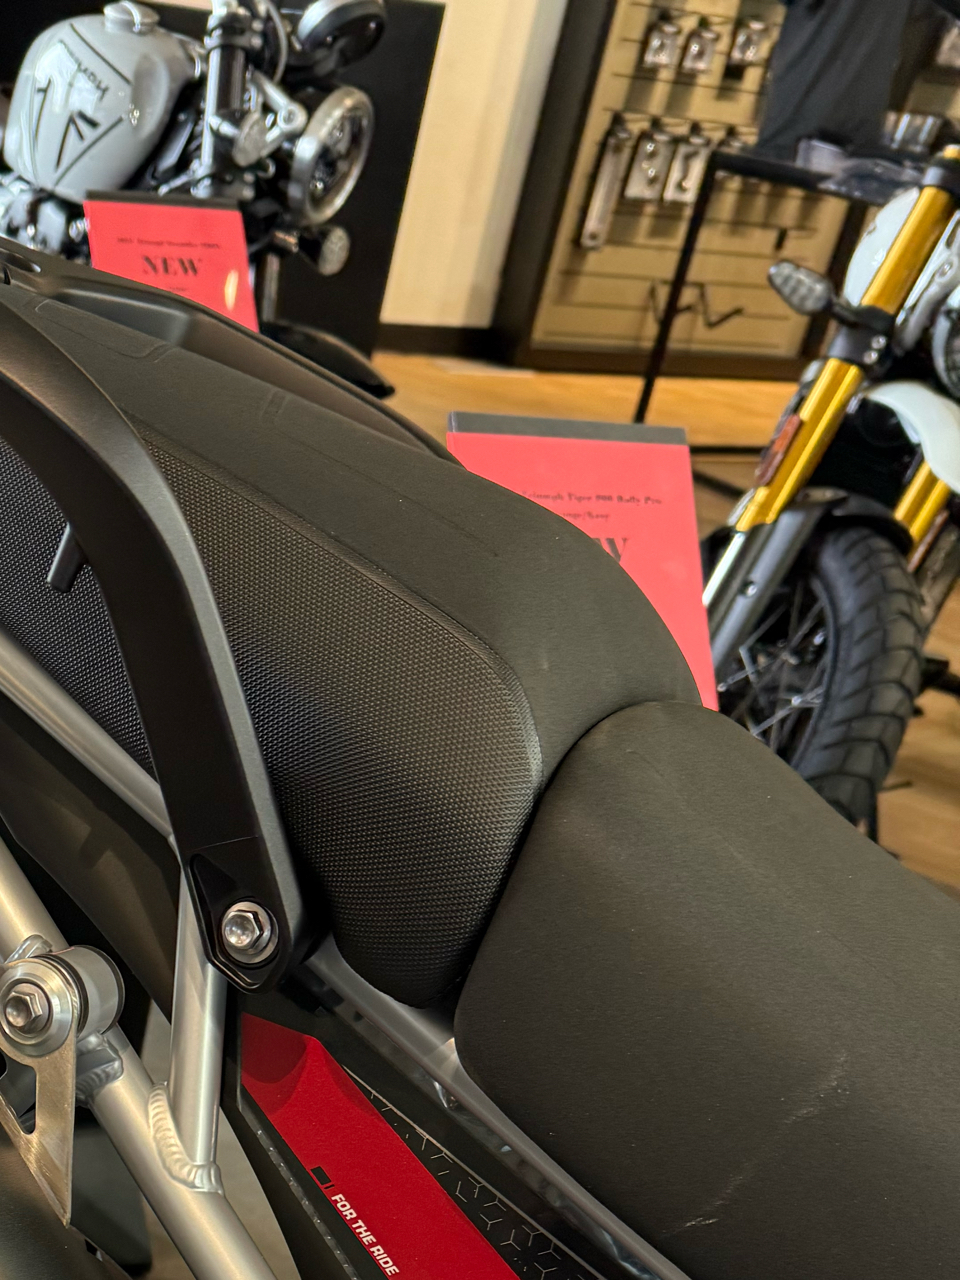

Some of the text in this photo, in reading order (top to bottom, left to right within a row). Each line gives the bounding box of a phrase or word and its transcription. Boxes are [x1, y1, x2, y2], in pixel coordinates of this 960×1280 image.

[143, 256, 203, 276] NEW
[568, 492, 592, 503] Tiger
[617, 494, 641, 506] Rally
[644, 496, 663, 505] Pro
[331, 1193, 400, 1276] FOR THE RIDE
